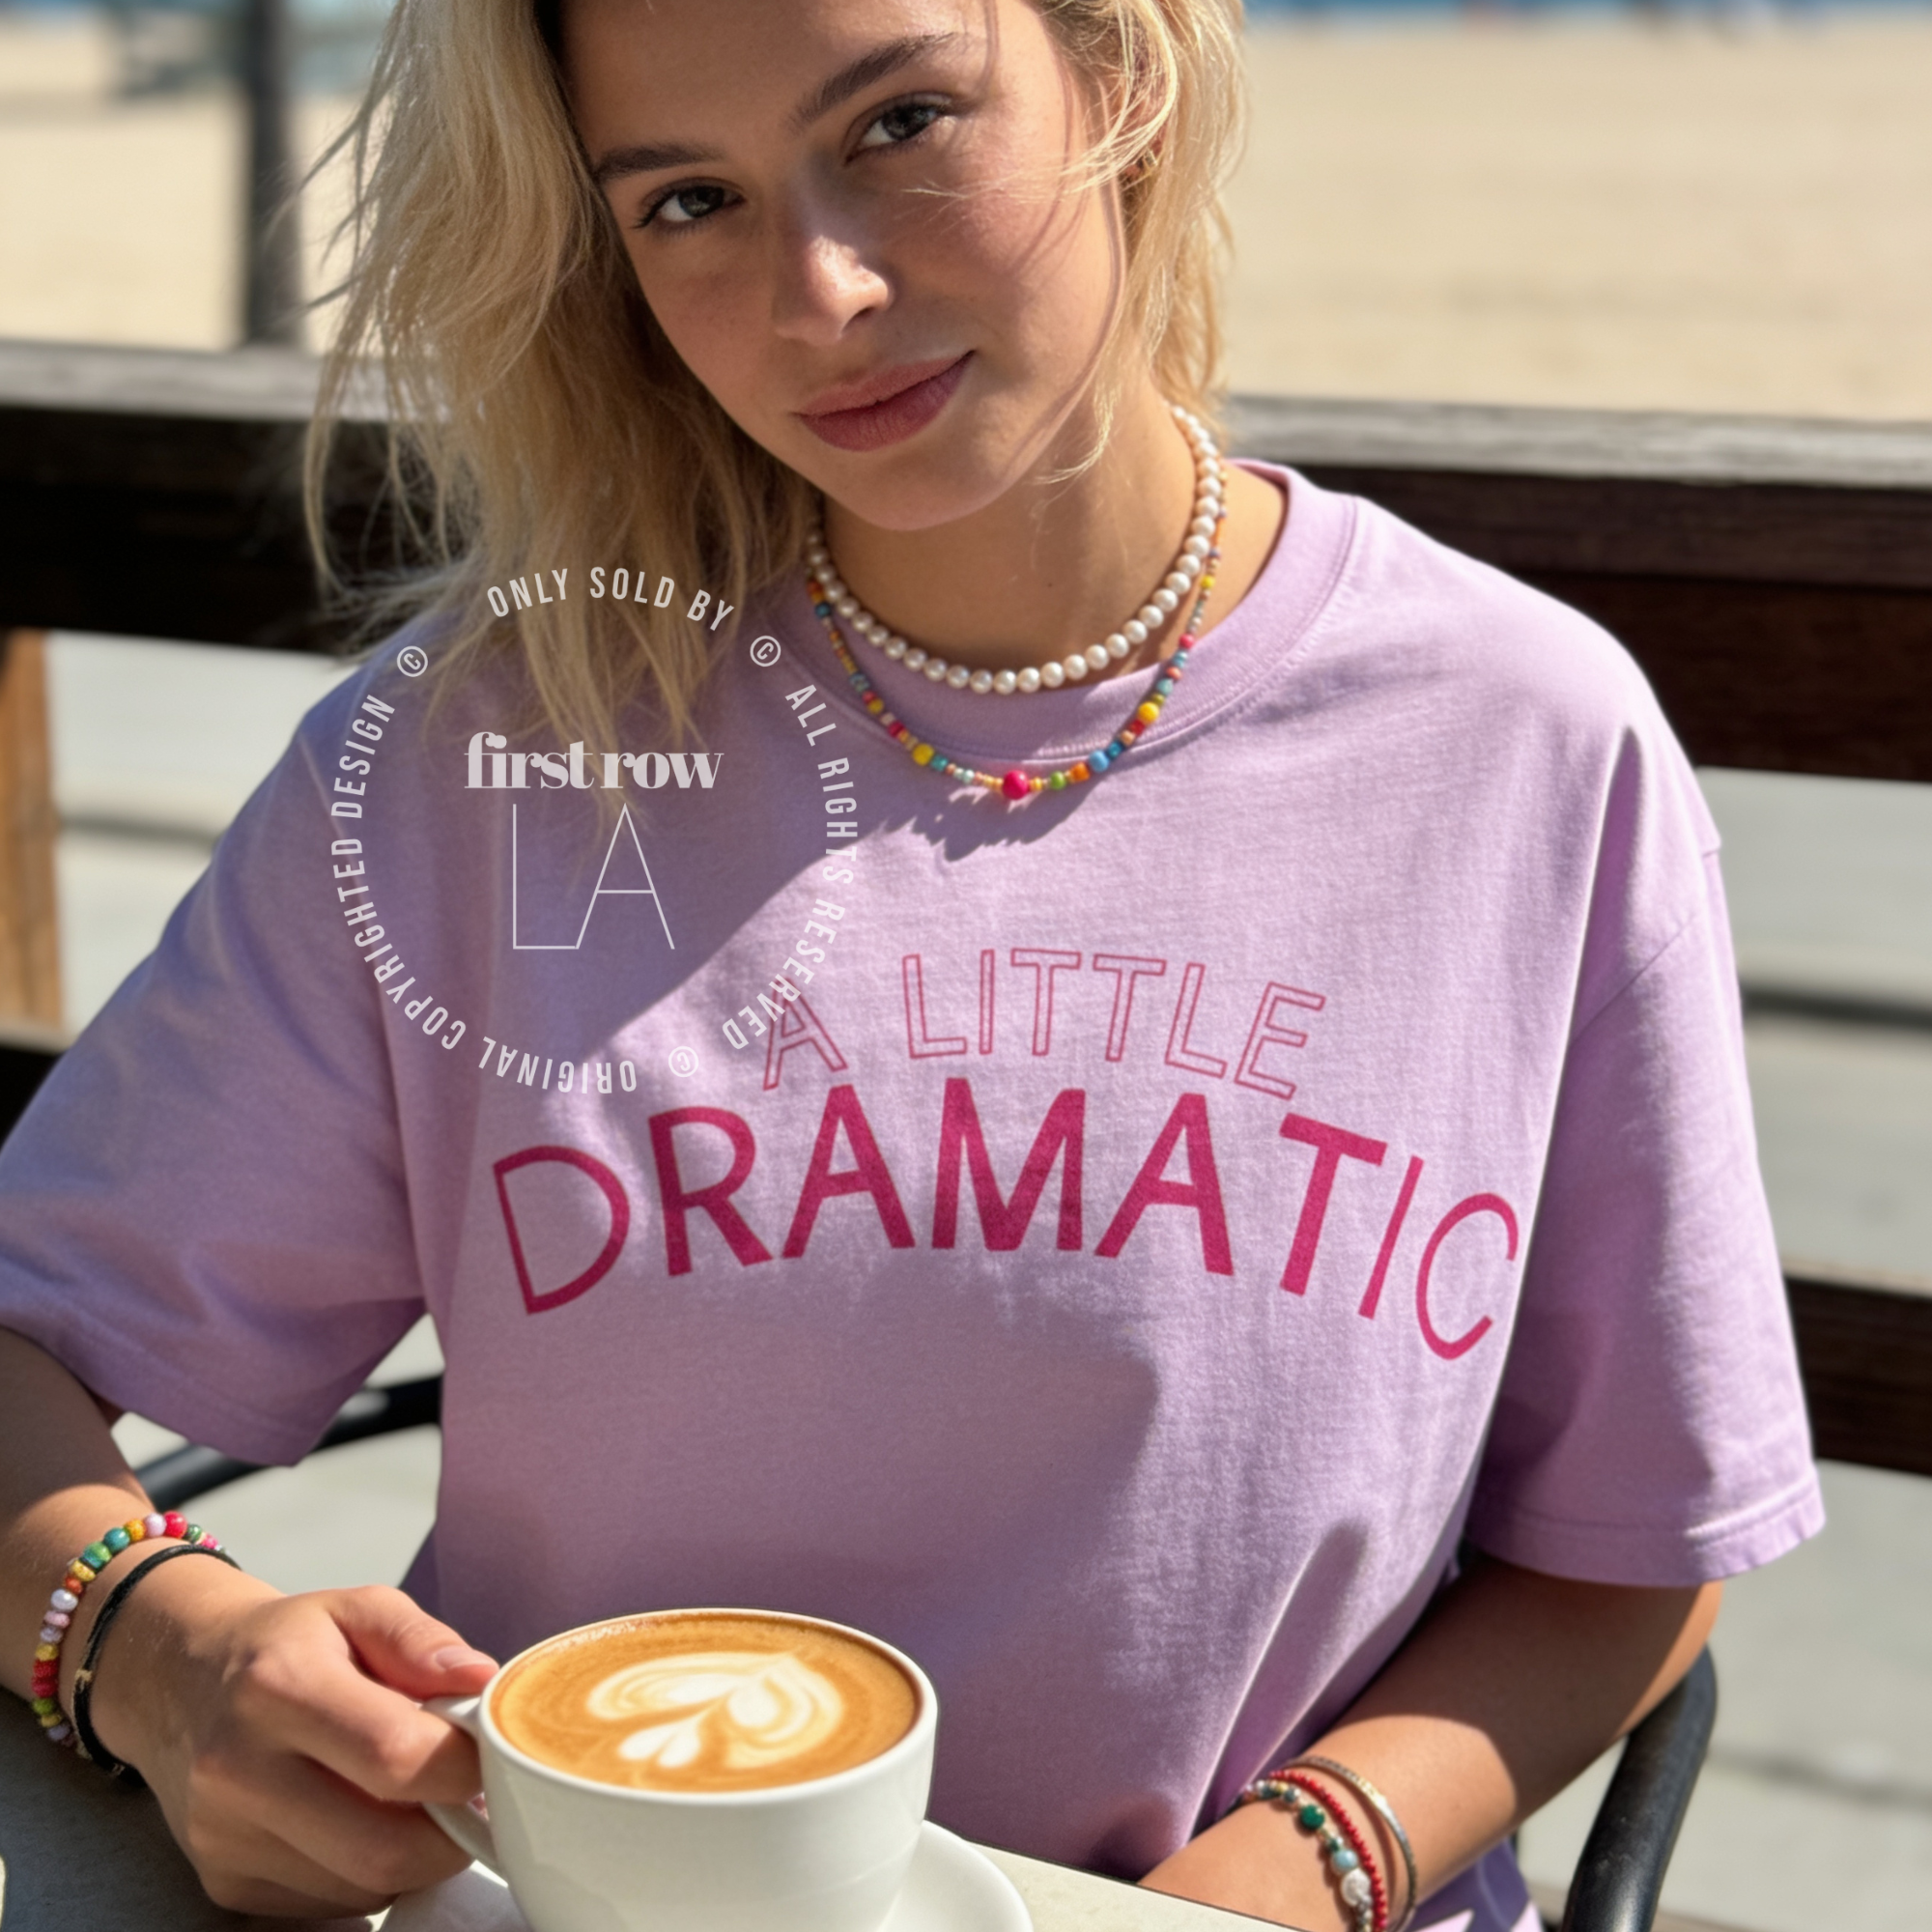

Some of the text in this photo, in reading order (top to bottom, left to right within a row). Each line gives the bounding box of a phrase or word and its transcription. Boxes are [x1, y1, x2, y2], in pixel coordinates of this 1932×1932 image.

[763, 949, 1325, 1099] A LITTLE
[493, 1077, 1520, 1360] DRAMATIC
